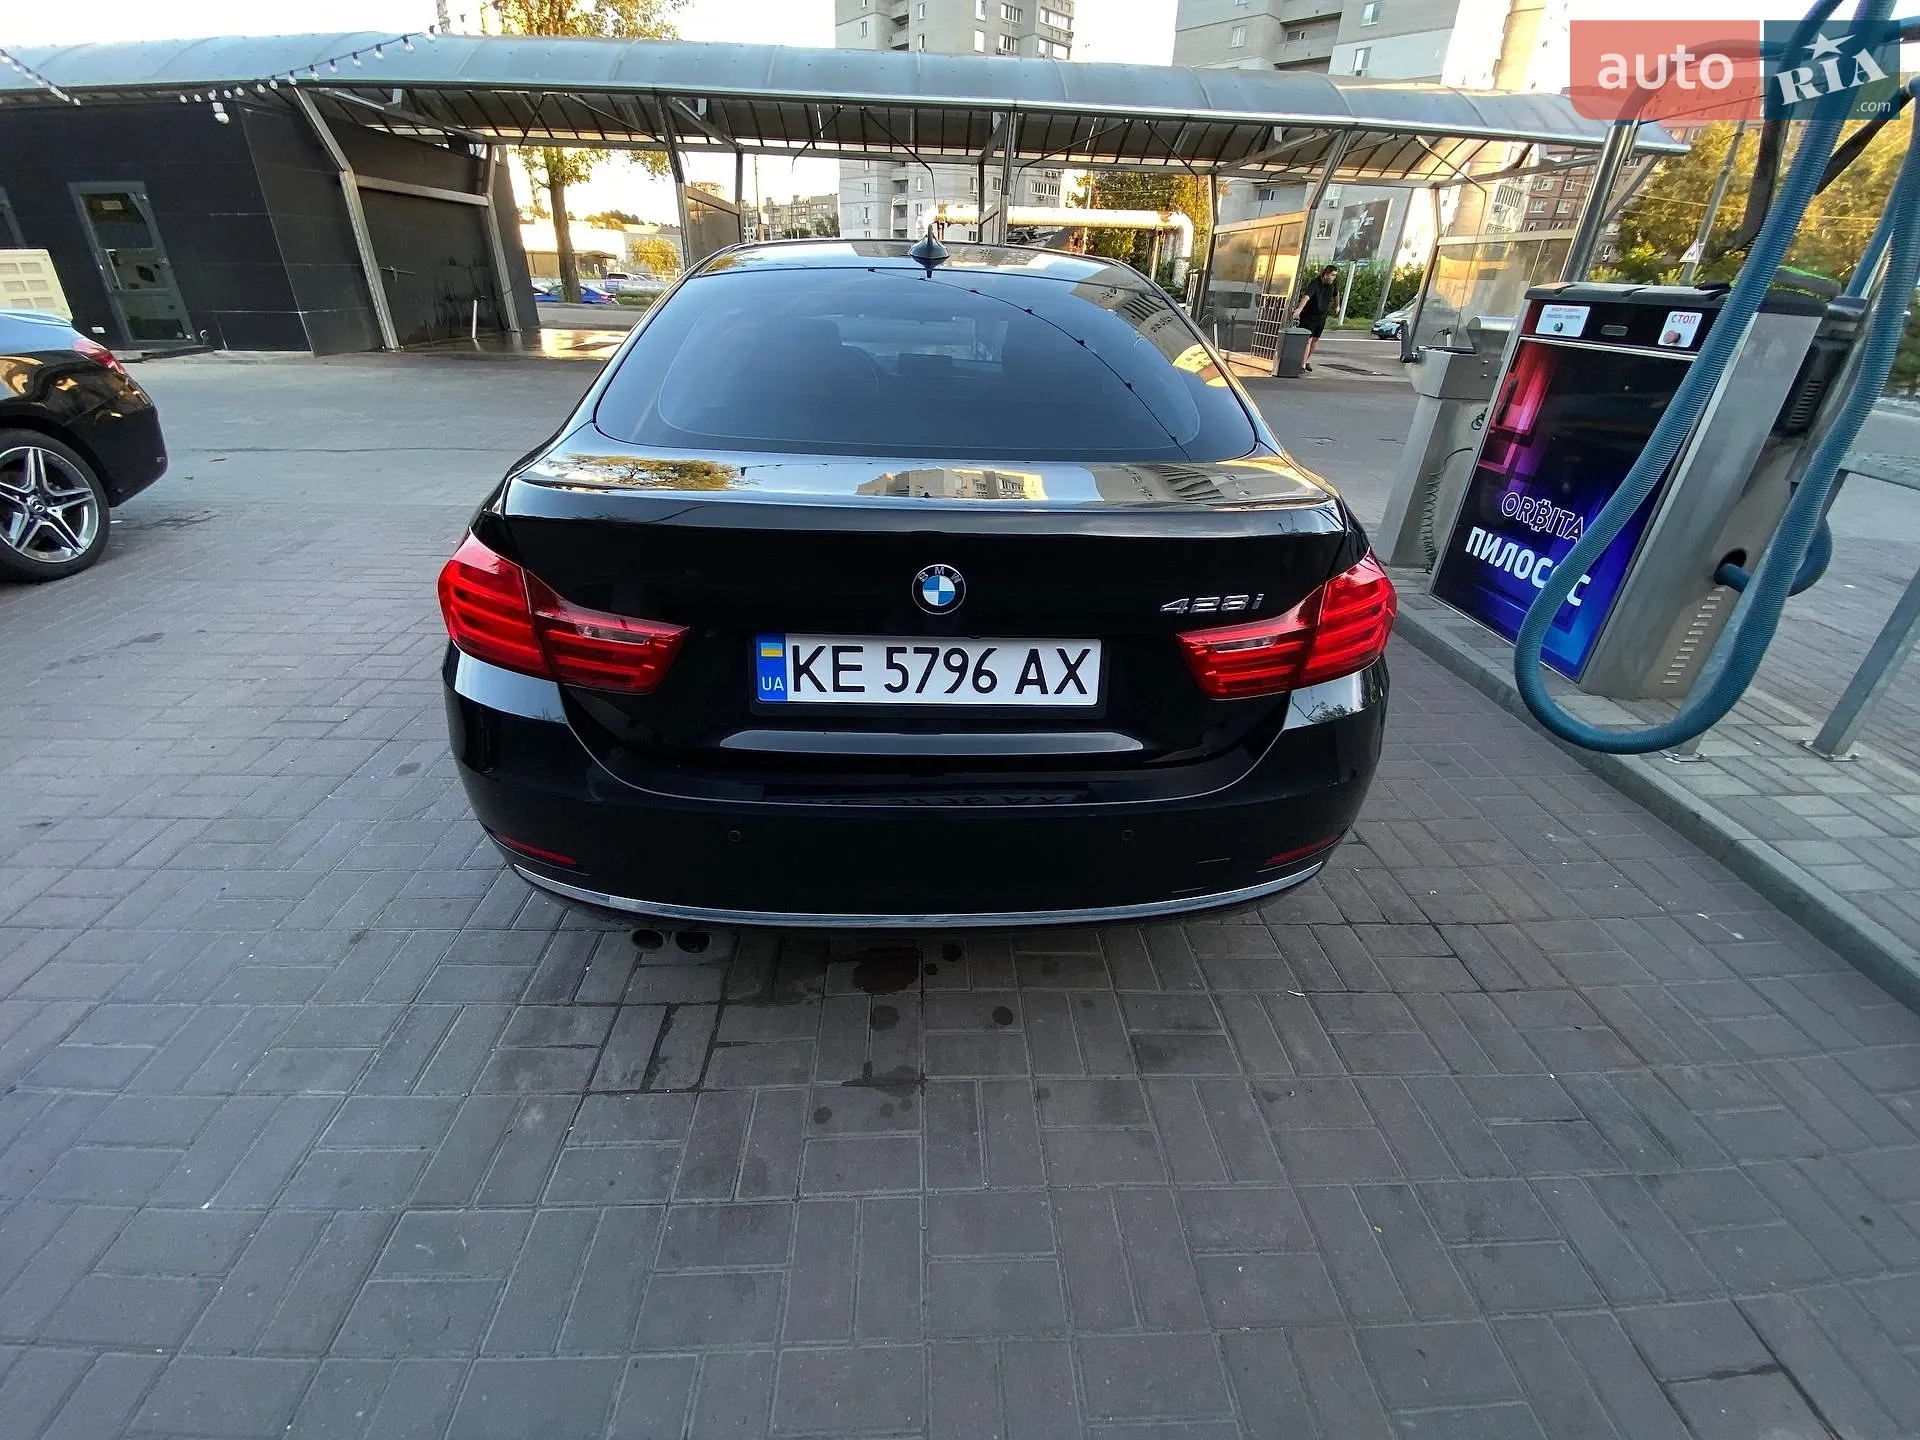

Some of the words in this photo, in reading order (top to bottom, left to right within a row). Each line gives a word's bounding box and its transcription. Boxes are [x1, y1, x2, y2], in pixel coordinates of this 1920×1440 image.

[1671, 313, 1697, 325] СТОП
[917, 566, 961, 584] BMW
[1464, 526, 1592, 607] ПИЛОСС
[1159, 593, 1265, 614] 428i
[792, 645, 866, 693] KE
[883, 646, 998, 694] 5796
[1014, 648, 1092, 695] AX
[761, 676, 785, 691] UA
